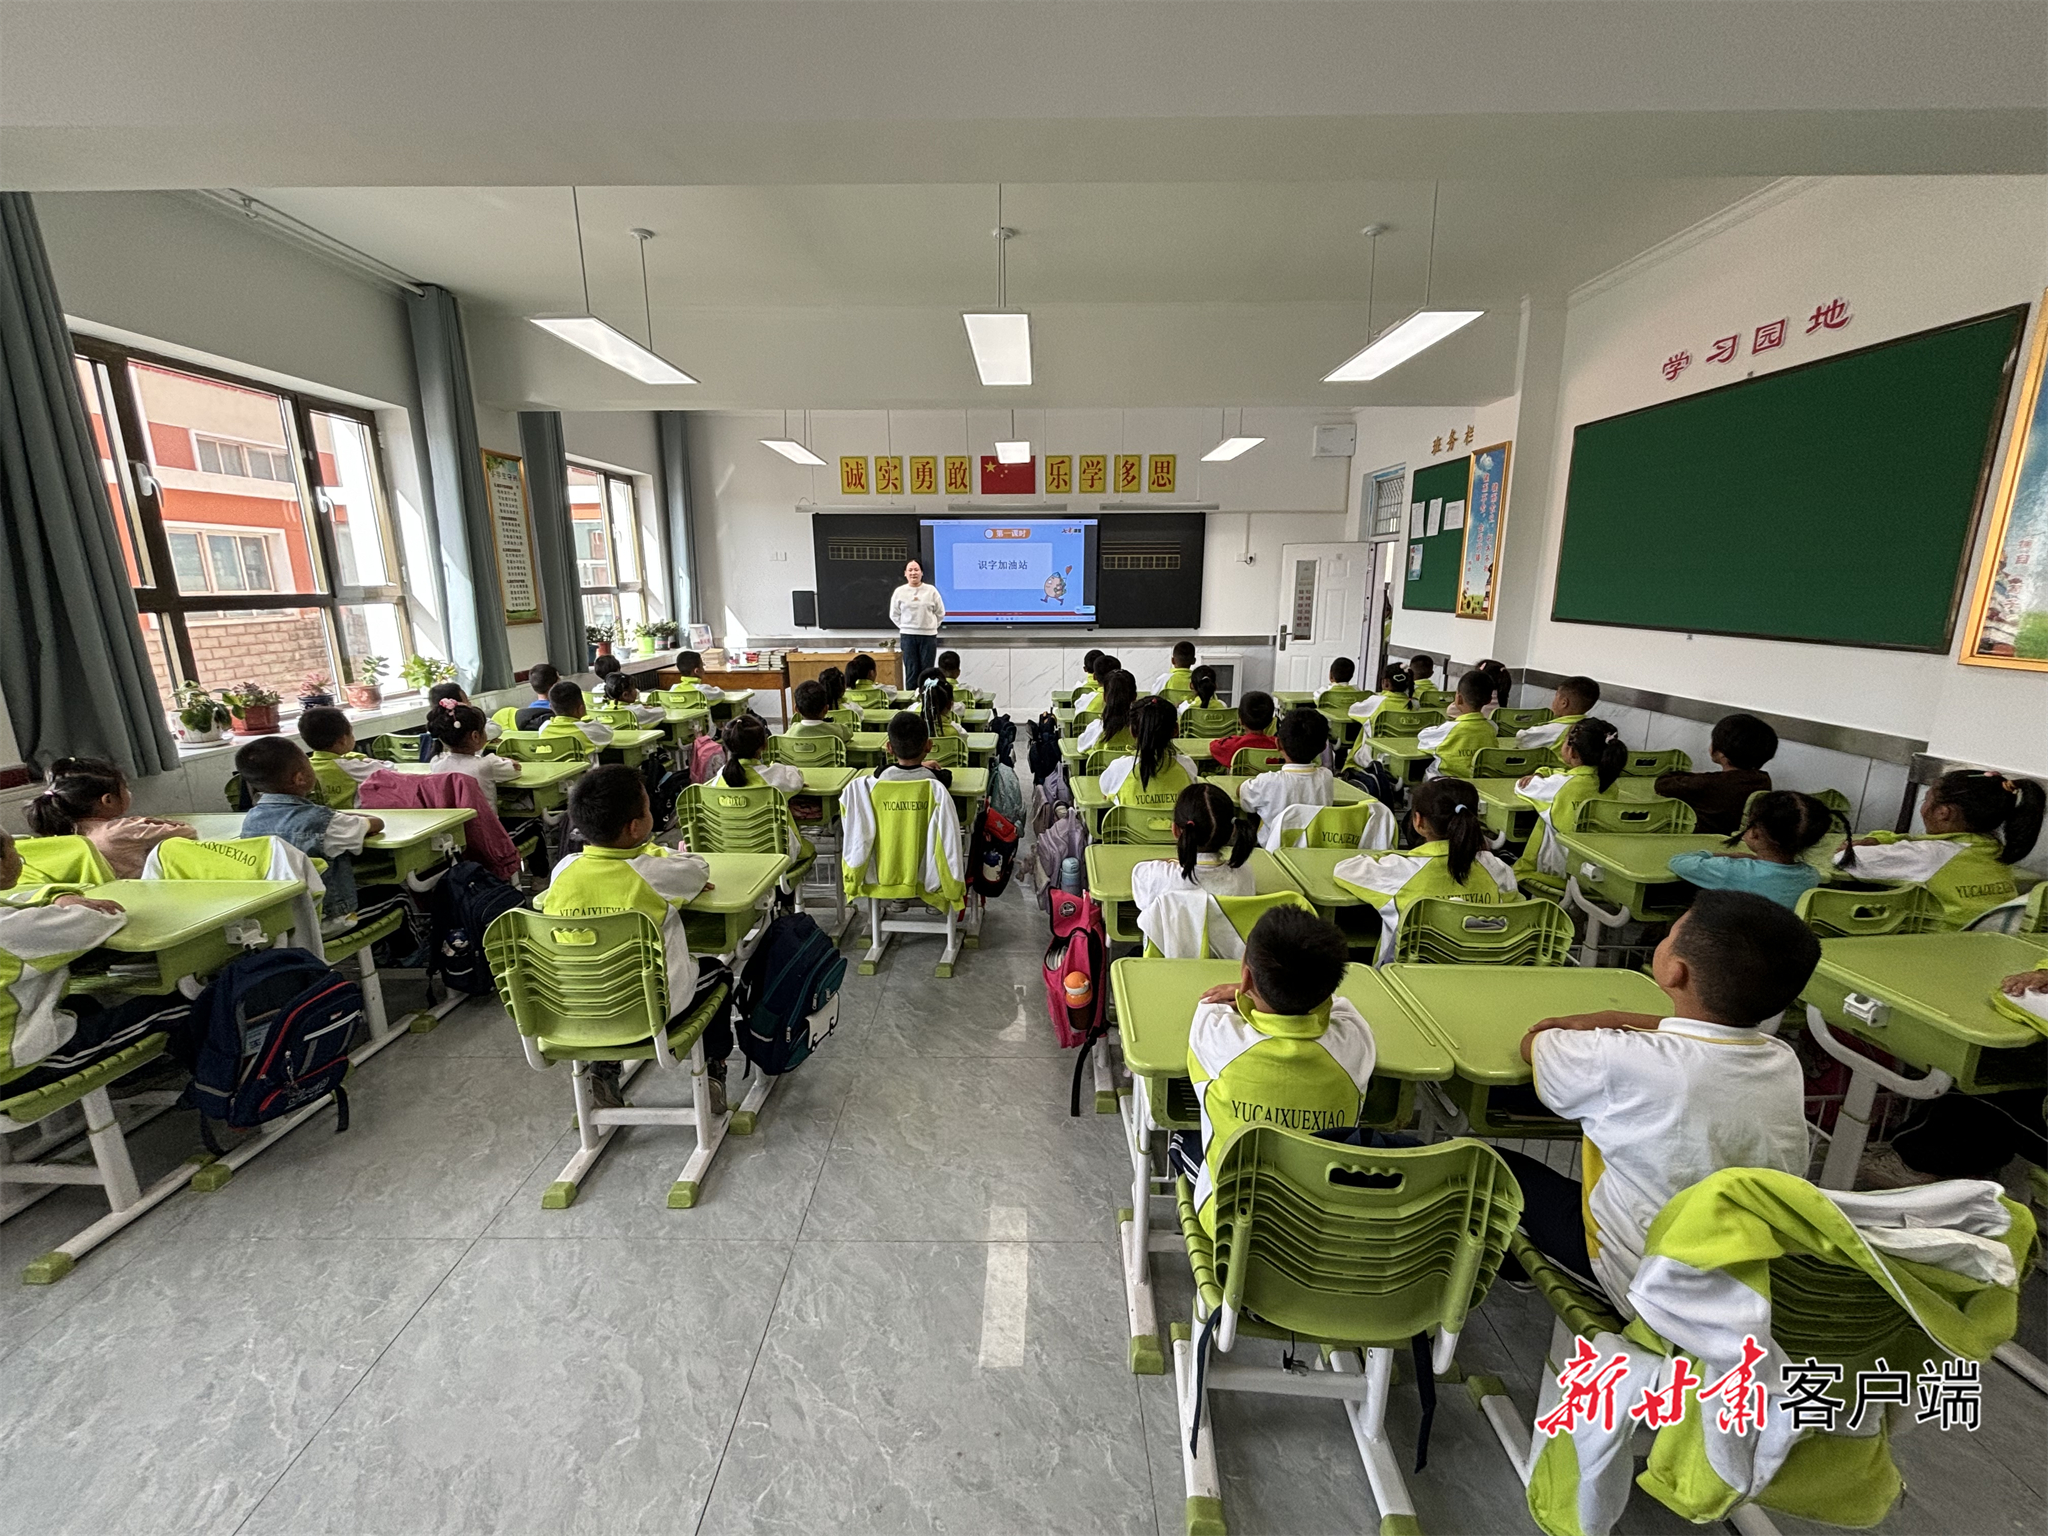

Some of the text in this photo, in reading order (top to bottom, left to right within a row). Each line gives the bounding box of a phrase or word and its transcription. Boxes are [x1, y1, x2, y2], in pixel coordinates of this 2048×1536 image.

[1662, 299, 1850, 381] 学习园地
[845, 461, 967, 490] 诚实勇敢
[1049, 460, 1171, 489] 乐学多思
[996, 529, 1026, 538] 第一课时
[978, 560, 1028, 570] 识字加油站
[883, 801, 928, 810] YUCAIXUEXO
[1232, 1100, 1345, 1130] YUCAIXUEXIAO
